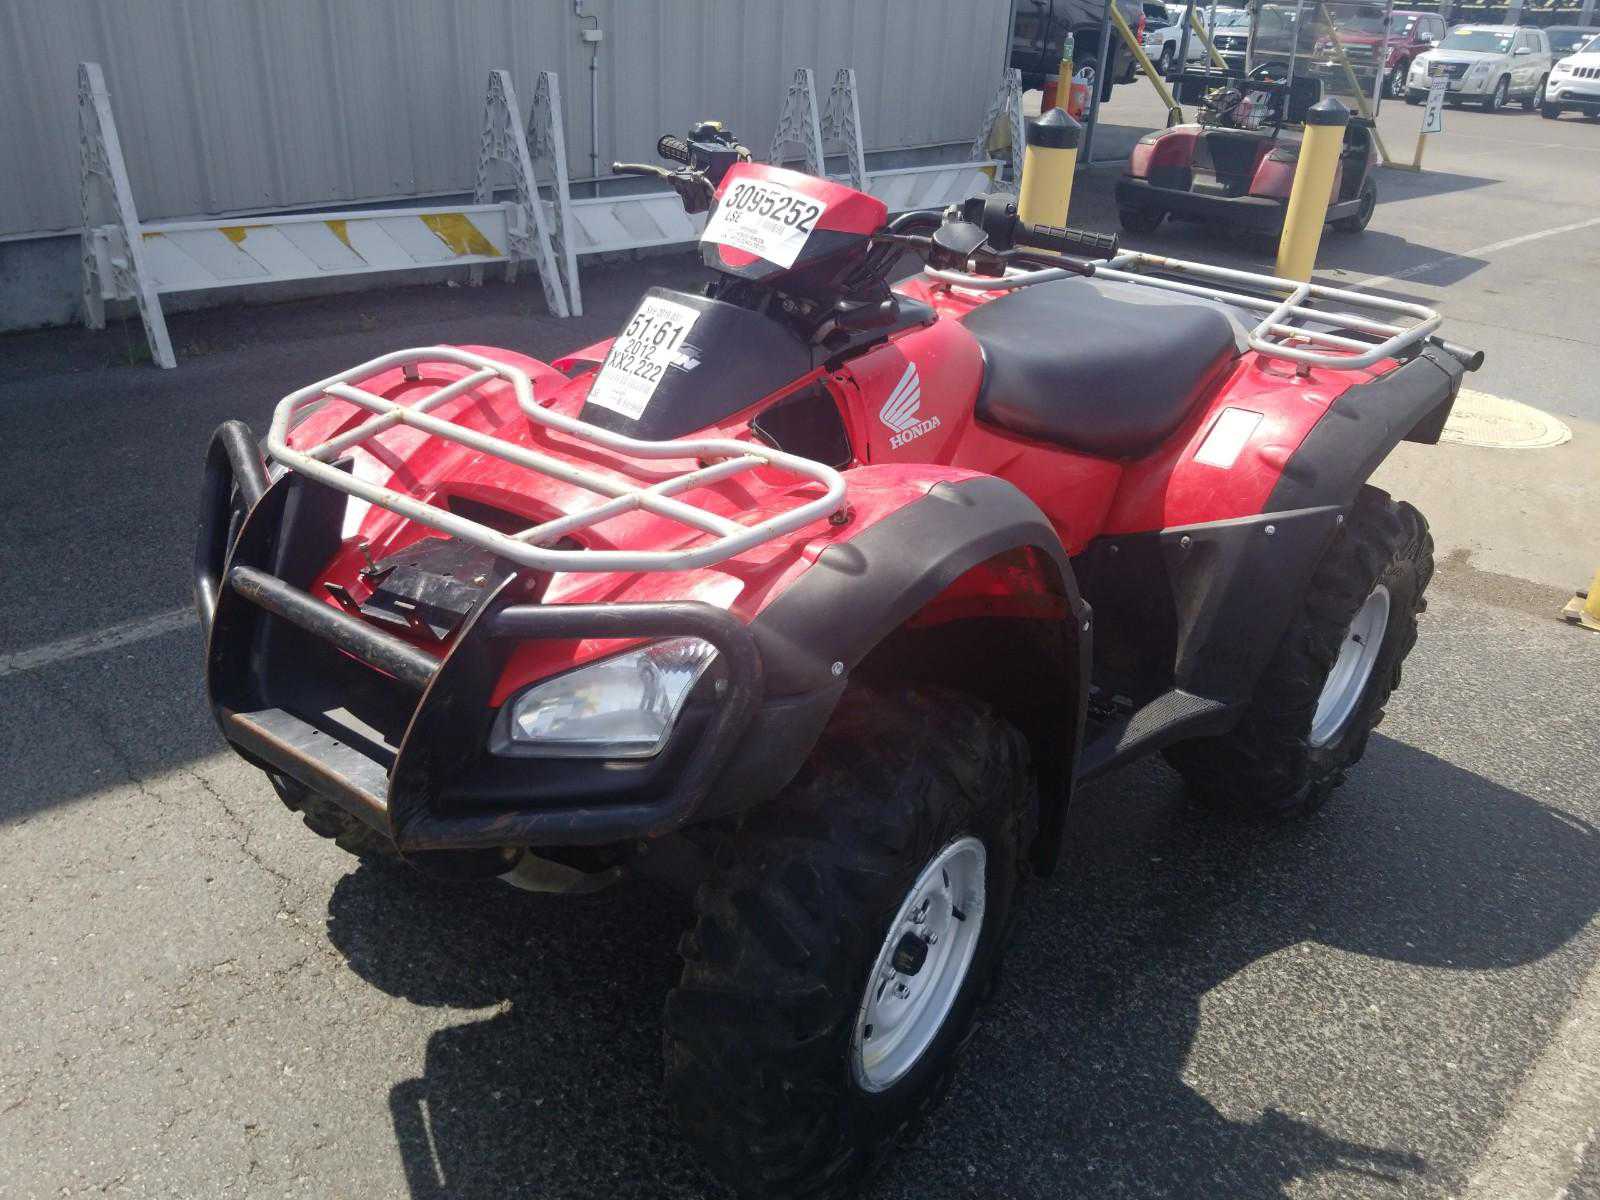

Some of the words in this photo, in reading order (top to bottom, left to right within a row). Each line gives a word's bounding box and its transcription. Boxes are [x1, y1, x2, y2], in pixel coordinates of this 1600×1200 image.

[1427, 106, 1436, 127] 5
[726, 183, 820, 234] 3095252
[626, 313, 684, 350] 51:61
[624, 338, 657, 361] 2012
[888, 415, 941, 449] HONDA
